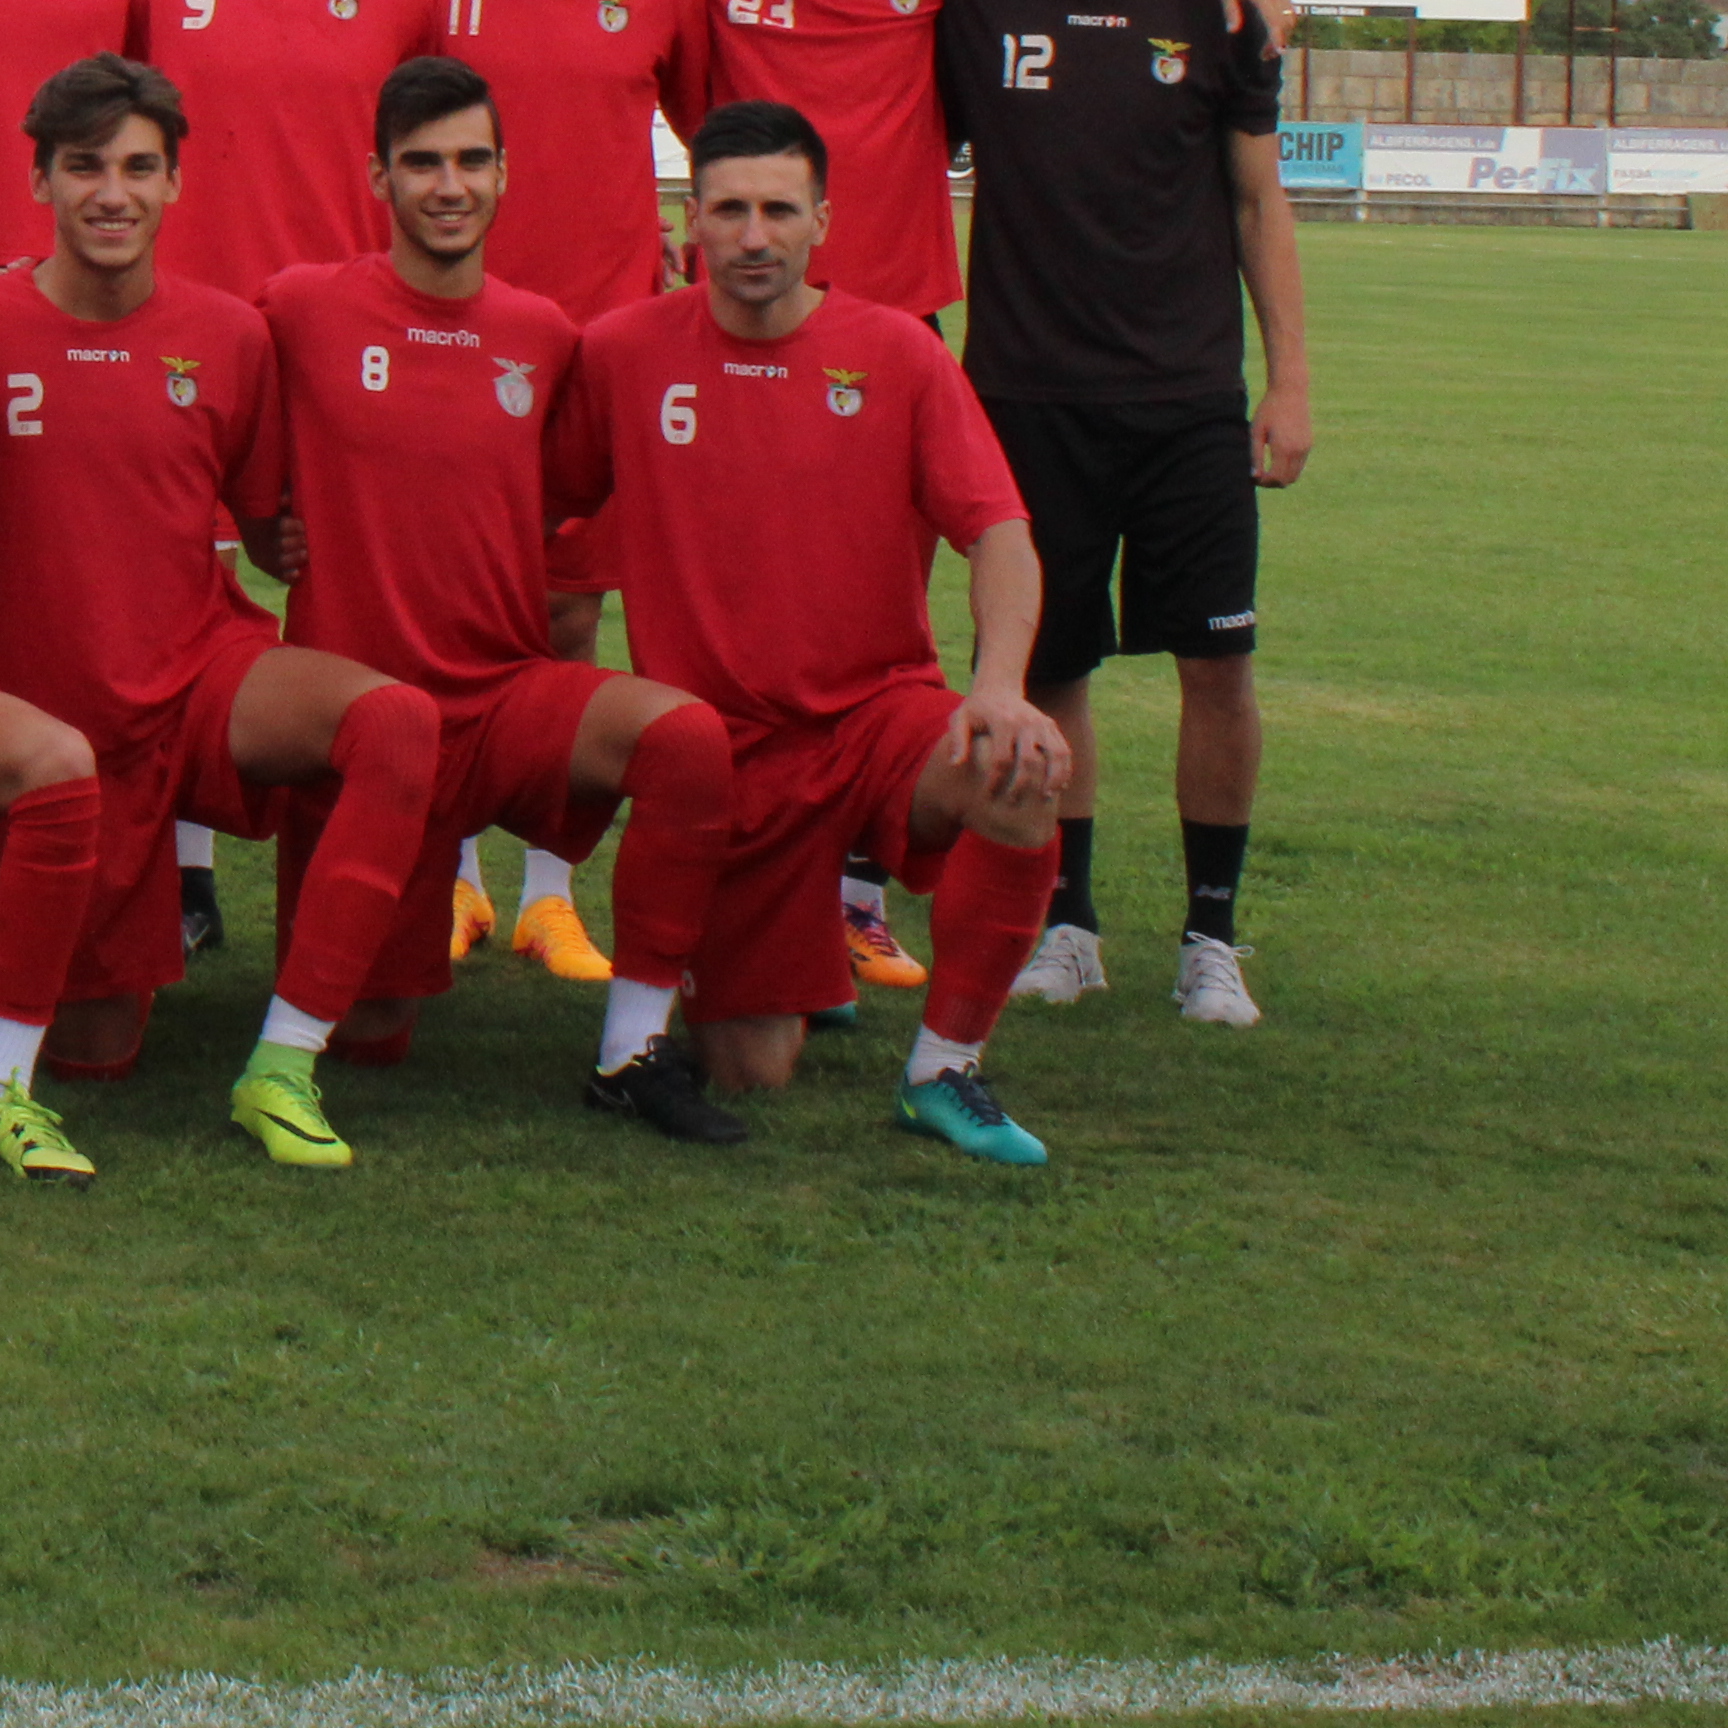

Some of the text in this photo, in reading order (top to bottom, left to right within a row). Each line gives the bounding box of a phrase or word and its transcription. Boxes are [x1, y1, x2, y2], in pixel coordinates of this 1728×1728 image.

[1068, 15, 1127, 27] macron
[1003, 34, 1053, 89] 12
[1279, 131, 1343, 161] CHIP
[408, 328, 480, 347] macron
[67, 349, 130, 362] macron
[362, 346, 389, 391] 8
[724, 363, 788, 378] macron
[8, 373, 44, 435] 2
[661, 384, 697, 444] 6
